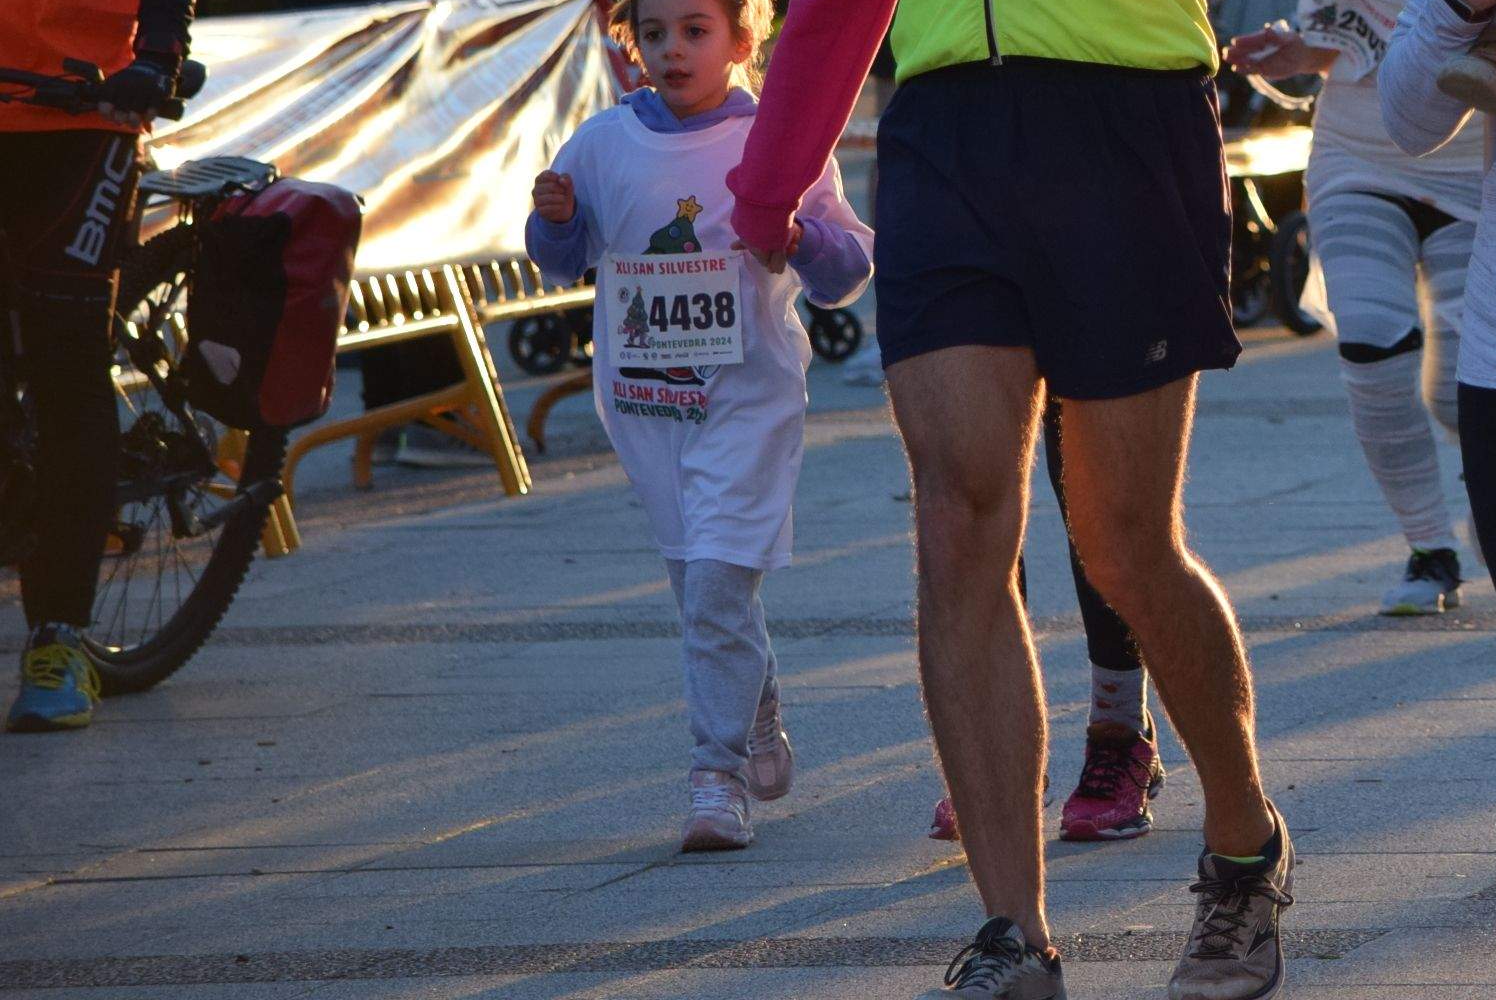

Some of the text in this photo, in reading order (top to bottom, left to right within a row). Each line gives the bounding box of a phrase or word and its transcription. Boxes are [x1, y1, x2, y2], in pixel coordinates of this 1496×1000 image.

[616, 258, 727, 275] XLI SAN SILVESTRE
[650, 291, 735, 332] 4438
[651, 337, 732, 349] PONTEVEDRA 2024
[628, 386, 654, 402] SAN
